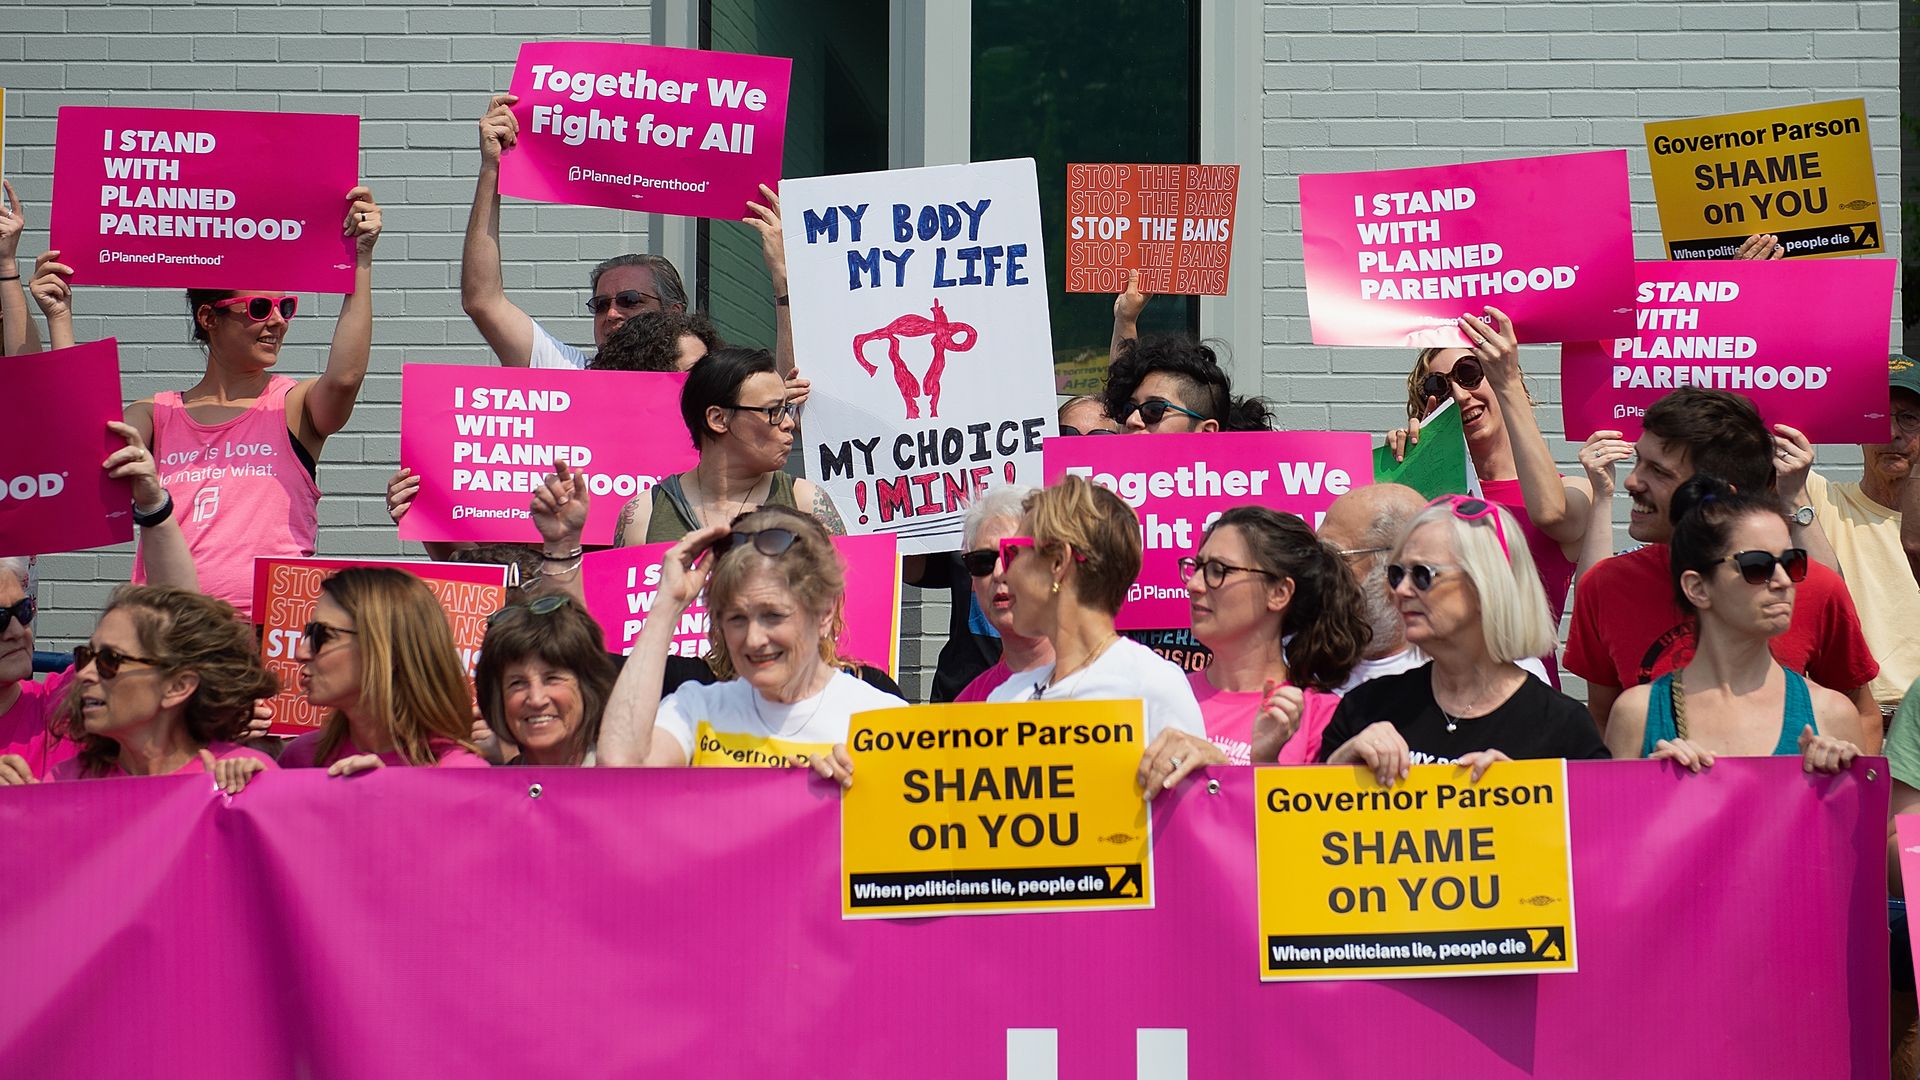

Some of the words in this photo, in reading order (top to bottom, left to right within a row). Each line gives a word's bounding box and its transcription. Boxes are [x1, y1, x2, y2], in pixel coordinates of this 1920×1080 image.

[531, 65, 698, 102] Together
[706, 78, 767, 111] We
[103, 129, 112, 152] I
[120, 130, 216, 155] STAND
[531, 104, 628, 146] Fight
[636, 113, 694, 148] for
[699, 123, 755, 154] All
[1654, 127, 1766, 155] Governor
[1772, 117, 1860, 142] Parson
[104, 157, 179, 181] WITH
[582, 169, 631, 185] Planned
[633, 175, 705, 193] Parenthood
[1072, 165, 1130, 189] STOP
[1138, 165, 1180, 190] THE
[1186, 166, 1235, 190] BANS
[1694, 152, 1822, 191] SHAME
[101, 185, 236, 211] PLANNED
[1071, 191, 1130, 214] STOP
[1138, 192, 1178, 215] THE
[1184, 192, 1232, 216] BANS
[1354, 195, 1364, 217] I
[1373, 187, 1476, 216] STAND
[1704, 200, 1744, 225] on
[1750, 187, 1828, 220] YOU
[803, 204, 870, 244] MY
[893, 199, 991, 243] BODY
[1071, 217, 1130, 240] STOP
[1138, 217, 1177, 241] THE
[1182, 218, 1229, 241] BANS
[1357, 219, 1440, 245] WITH
[111, 252, 155, 263] Planned
[1071, 242, 1130, 266] STOP
[1138, 243, 1174, 267] THE
[1179, 244, 1227, 268] BANS
[1358, 243, 1503, 272] PLANNED
[1674, 247, 1706, 260] When
[1707, 245, 1741, 259] politic
[1787, 235, 1829, 252] people
[1830, 234, 1850, 245] die
[847, 247, 915, 291] MY
[933, 243, 1029, 288] LIFE
[1070, 268, 1130, 291] STOP
[1138, 269, 1171, 292] THE
[1176, 269, 1225, 294] BANS
[1636, 281, 1740, 303] STAND
[1613, 336, 1758, 359] PLANNED
[454, 387, 464, 408] I
[471, 388, 571, 412] STAND
[455, 414, 534, 438] WITH
[204, 444, 219, 460] is
[225, 441, 278, 458] Love.
[454, 442, 592, 467] PLANNED
[819, 436, 881, 481] MY
[892, 417, 1046, 471] CHOICE
[175, 467, 226, 482] matter
[231, 463, 277, 477] what.
[1279, 462, 1351, 495] We
[465, 507, 510, 519] Planned
[853, 727, 1008, 751] Governor
[1017, 721, 1133, 746] Parson
[903, 765, 1075, 803] SHAME
[1267, 788, 1428, 813] Governor
[1436, 784, 1553, 809] Parson
[909, 823, 966, 850] on
[978, 813, 1079, 848] YOU
[1322, 827, 1495, 865] SHAME
[854, 883, 900, 899] When
[904, 879, 989, 900] politicians
[991, 877, 1015, 896] lie,
[1018, 876, 1075, 896] people
[1077, 875, 1104, 891] die
[1328, 886, 1386, 913] on
[1398, 875, 1500, 912] YOU
[1272, 946, 1321, 962] When
[1324, 942, 1410, 964] politicians
[1412, 940, 1437, 960] lie,
[1440, 939, 1497, 959] people
[1499, 938, 1526, 955] die
